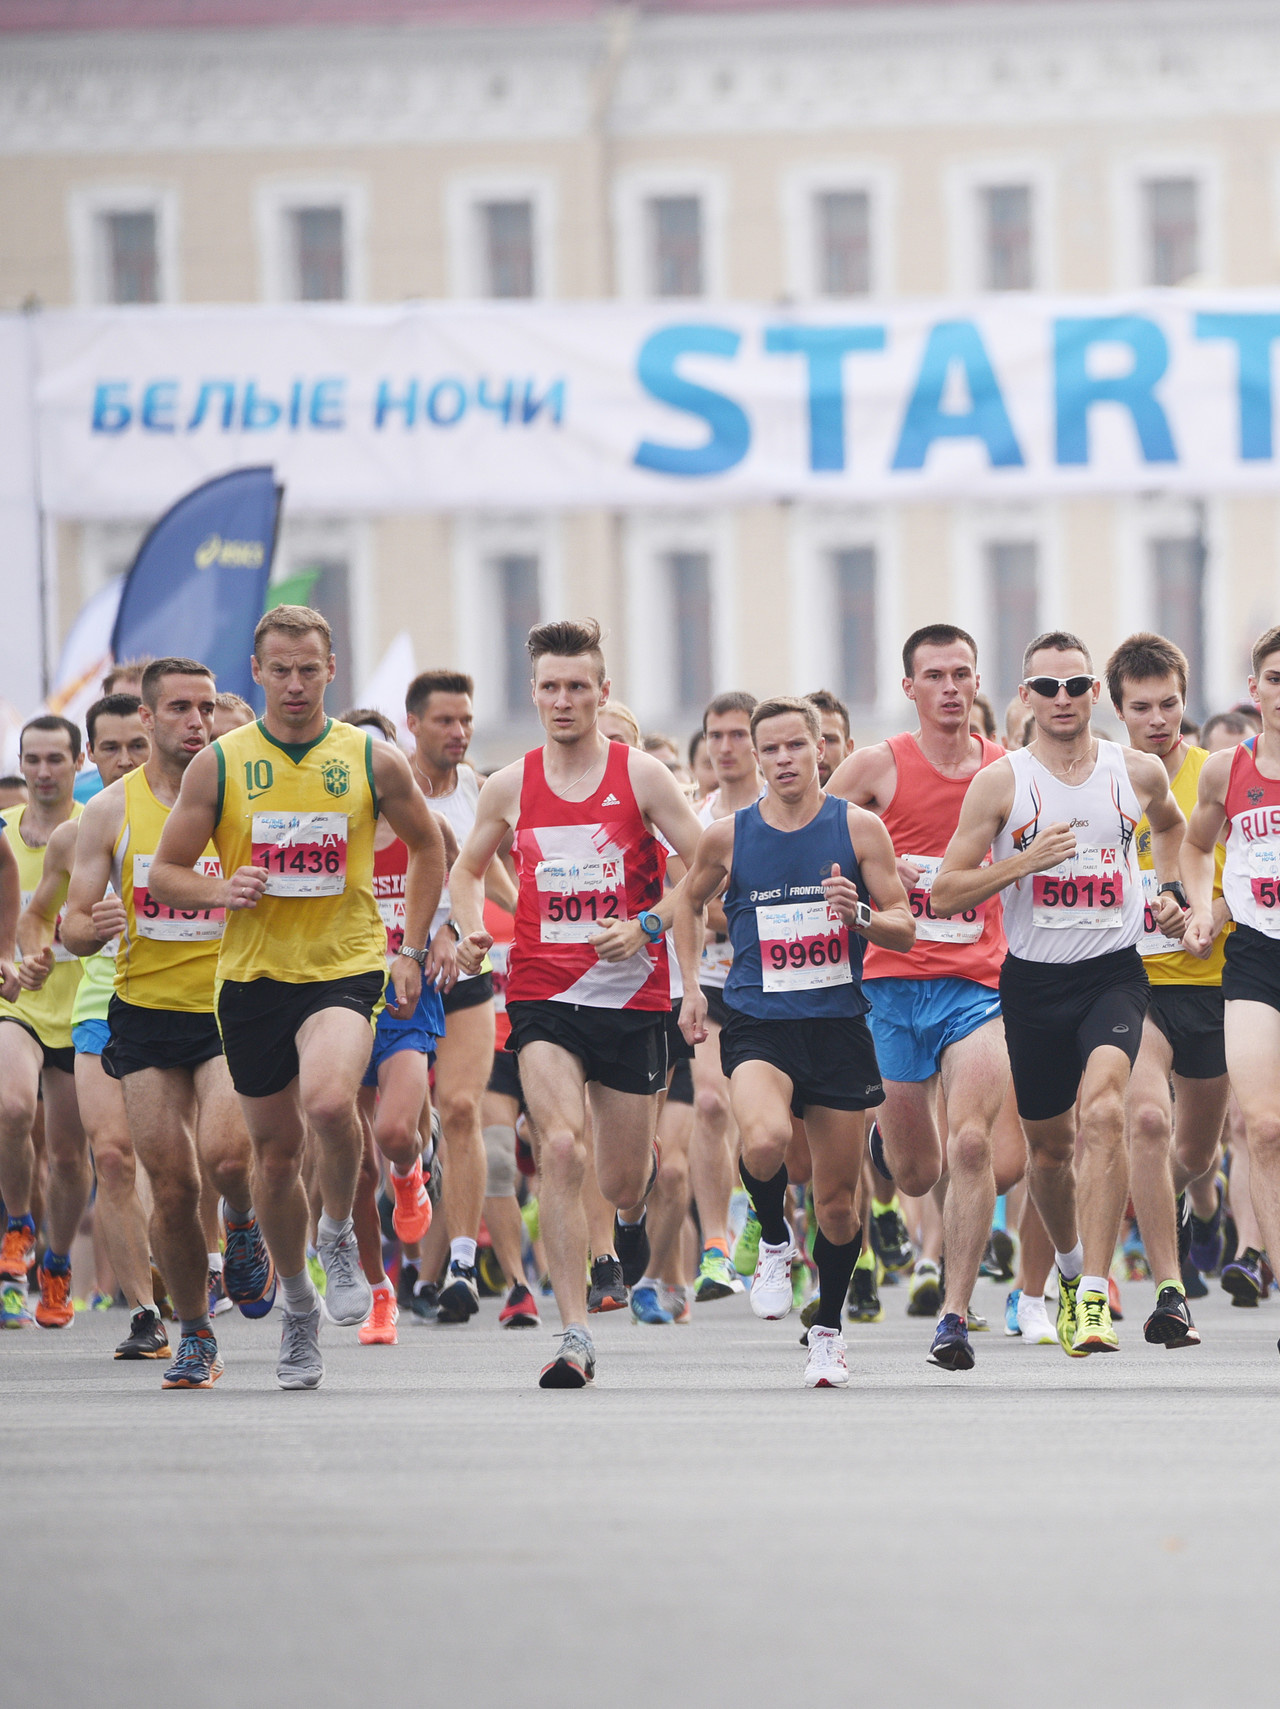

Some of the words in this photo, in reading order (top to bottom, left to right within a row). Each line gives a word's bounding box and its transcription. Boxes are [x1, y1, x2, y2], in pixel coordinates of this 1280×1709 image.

[91, 376, 346, 437] БЕЛЫЕ
[373, 375, 566, 431] НОЧИ
[244, 759, 274, 791] 10
[259, 850, 340, 874] 11436
[758, 888, 782, 901] asics
[1042, 881, 1116, 907] 5015
[548, 895, 619, 922] 5012
[770, 938, 842, 970] 9960
